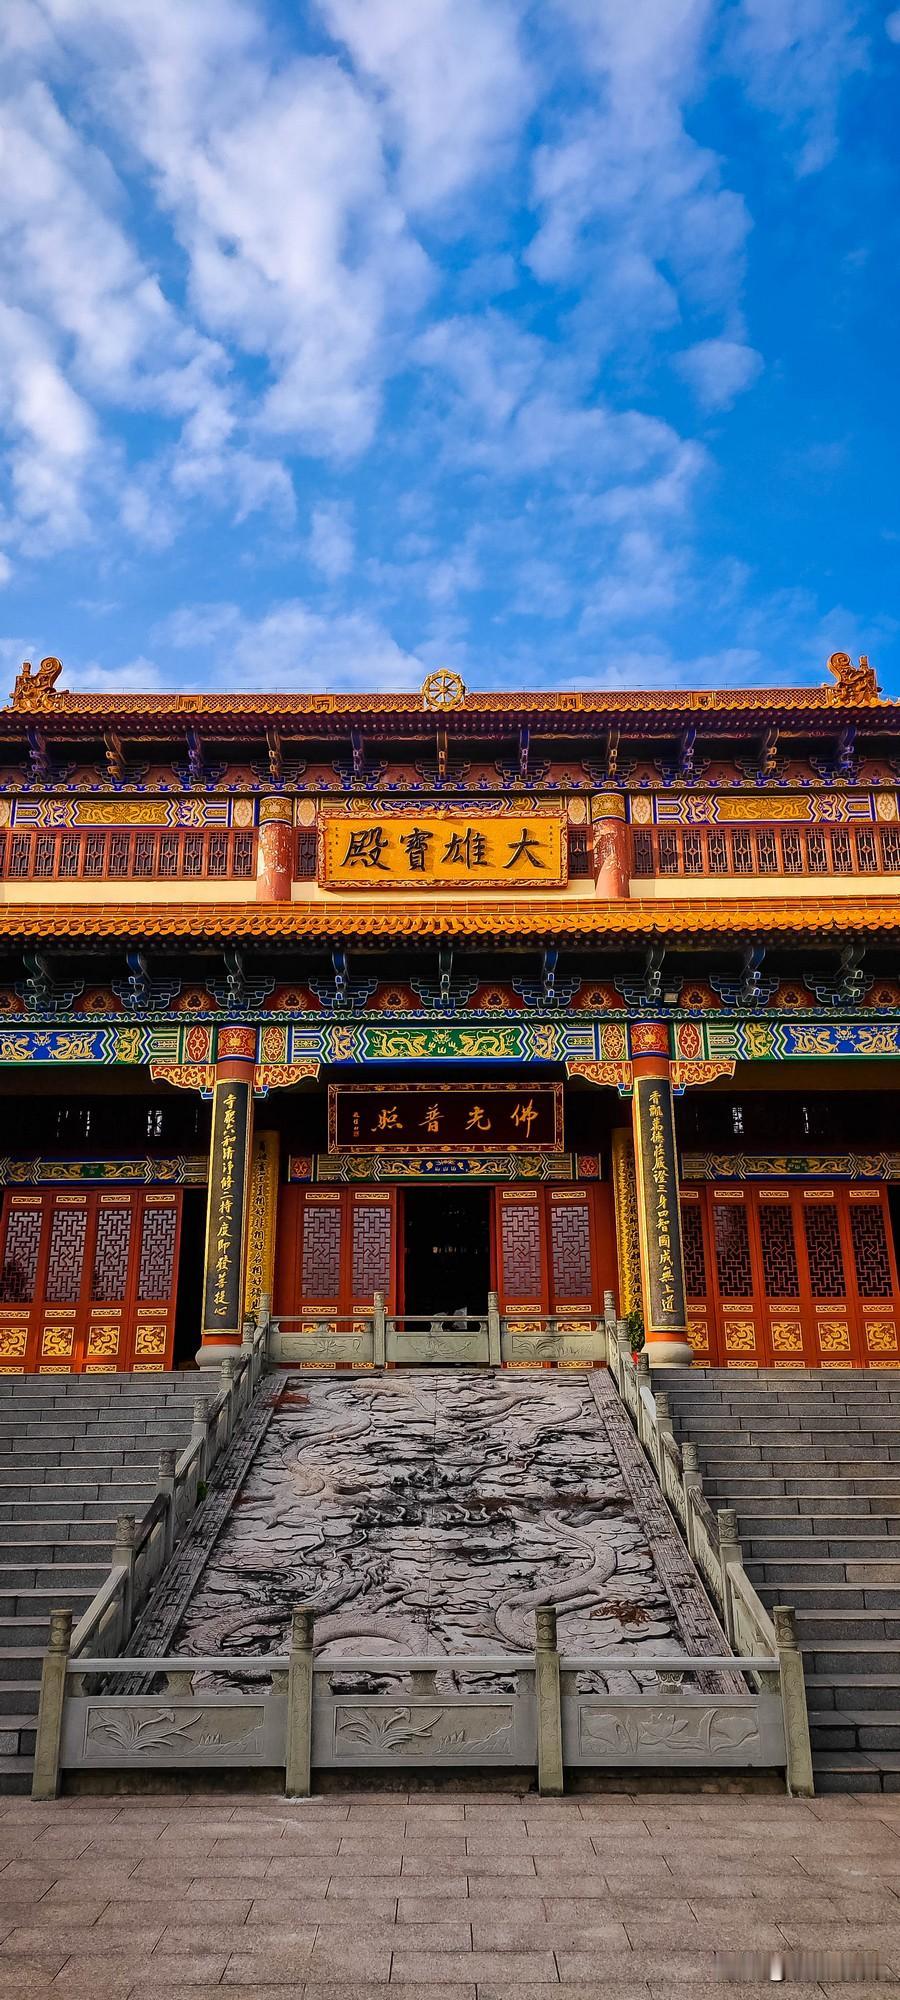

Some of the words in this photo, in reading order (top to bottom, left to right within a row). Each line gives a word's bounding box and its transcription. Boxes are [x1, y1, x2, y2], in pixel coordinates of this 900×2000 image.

[340, 826, 545, 871] 大雄寶殿
[371, 1099, 539, 1138] 佛光普照
